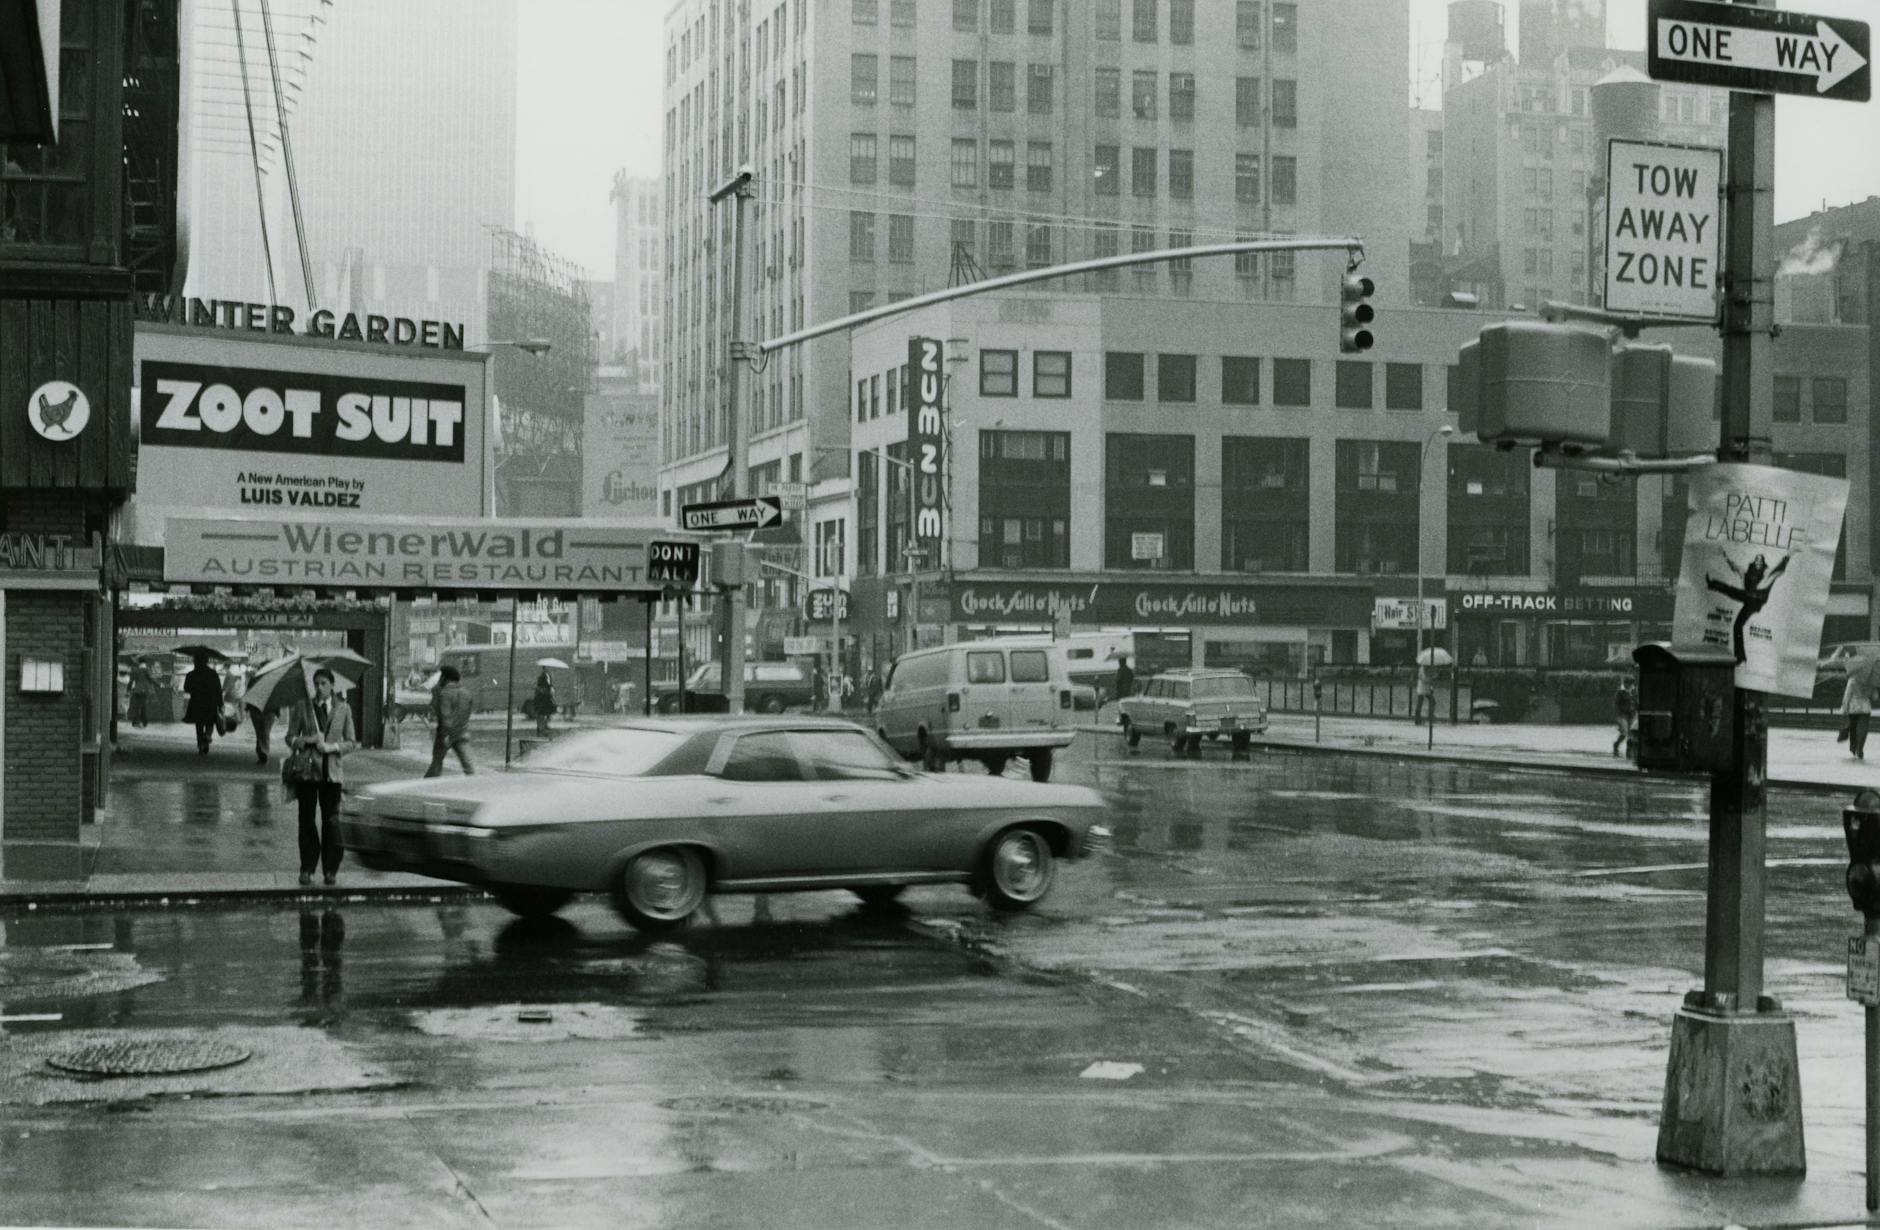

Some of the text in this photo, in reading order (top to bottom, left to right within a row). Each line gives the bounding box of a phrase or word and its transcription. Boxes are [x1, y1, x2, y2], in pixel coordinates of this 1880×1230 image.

[1668, 24, 1839, 72] ONE WAY
[1633, 163, 1698, 199] TOW
[1615, 207, 1710, 244] AWAY
[1616, 251, 1708, 289] ZONE
[141, 293, 465, 350] WINTER GARDEN
[155, 379, 463, 447] ZOOT SUIT
[237, 471, 365, 492] A New American Play by
[241, 487, 361, 509] LUIS VALDEZ
[1726, 494, 1787, 523] PATTI
[690, 507, 766, 527] ONE WAY
[1705, 515, 1806, 553] LABELLE
[651, 545, 692, 561] DONT
[202, 557, 644, 583] AUSTRIAN RESTAURANT
[1463, 594, 1633, 612] OFF-TRACK BETTING
